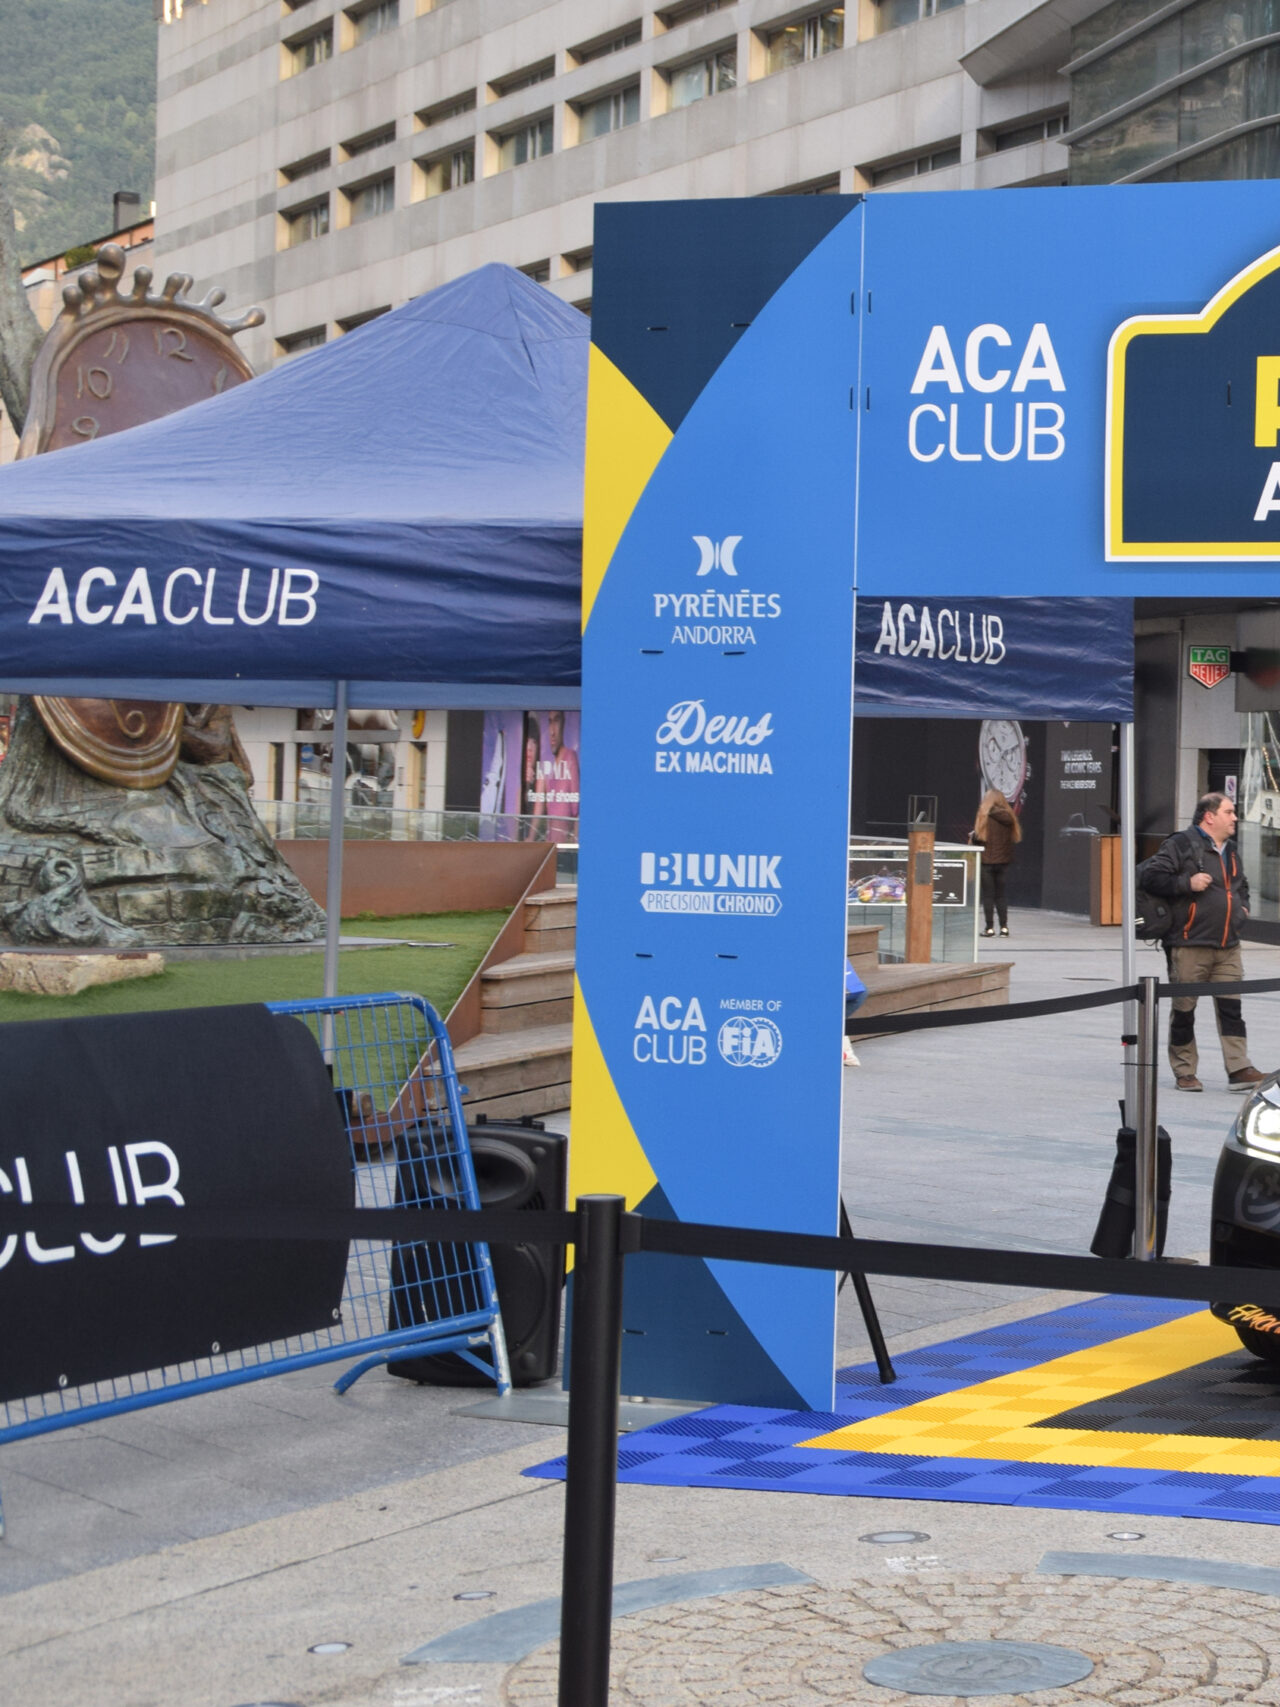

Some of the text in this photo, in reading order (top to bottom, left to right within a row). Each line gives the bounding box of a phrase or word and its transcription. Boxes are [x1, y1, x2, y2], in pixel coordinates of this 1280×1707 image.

[909, 322, 1067, 394] ACA
[908, 402, 1066, 463] CLUB
[671, 625, 757, 645] ANDORRA
[1194, 649, 1228, 662] TAG
[1192, 664, 1228, 684] HEUER
[655, 699, 774, 746] Deus
[655, 751, 774, 775] EX MACHINA
[640, 852, 783, 889] BLUNIK
[647, 893, 775, 913] PRECISION CHRONO
[634, 995, 707, 1032] ACA
[719, 998, 783, 1012] MEMBER OF
[633, 1033, 707, 1065] CLUB
